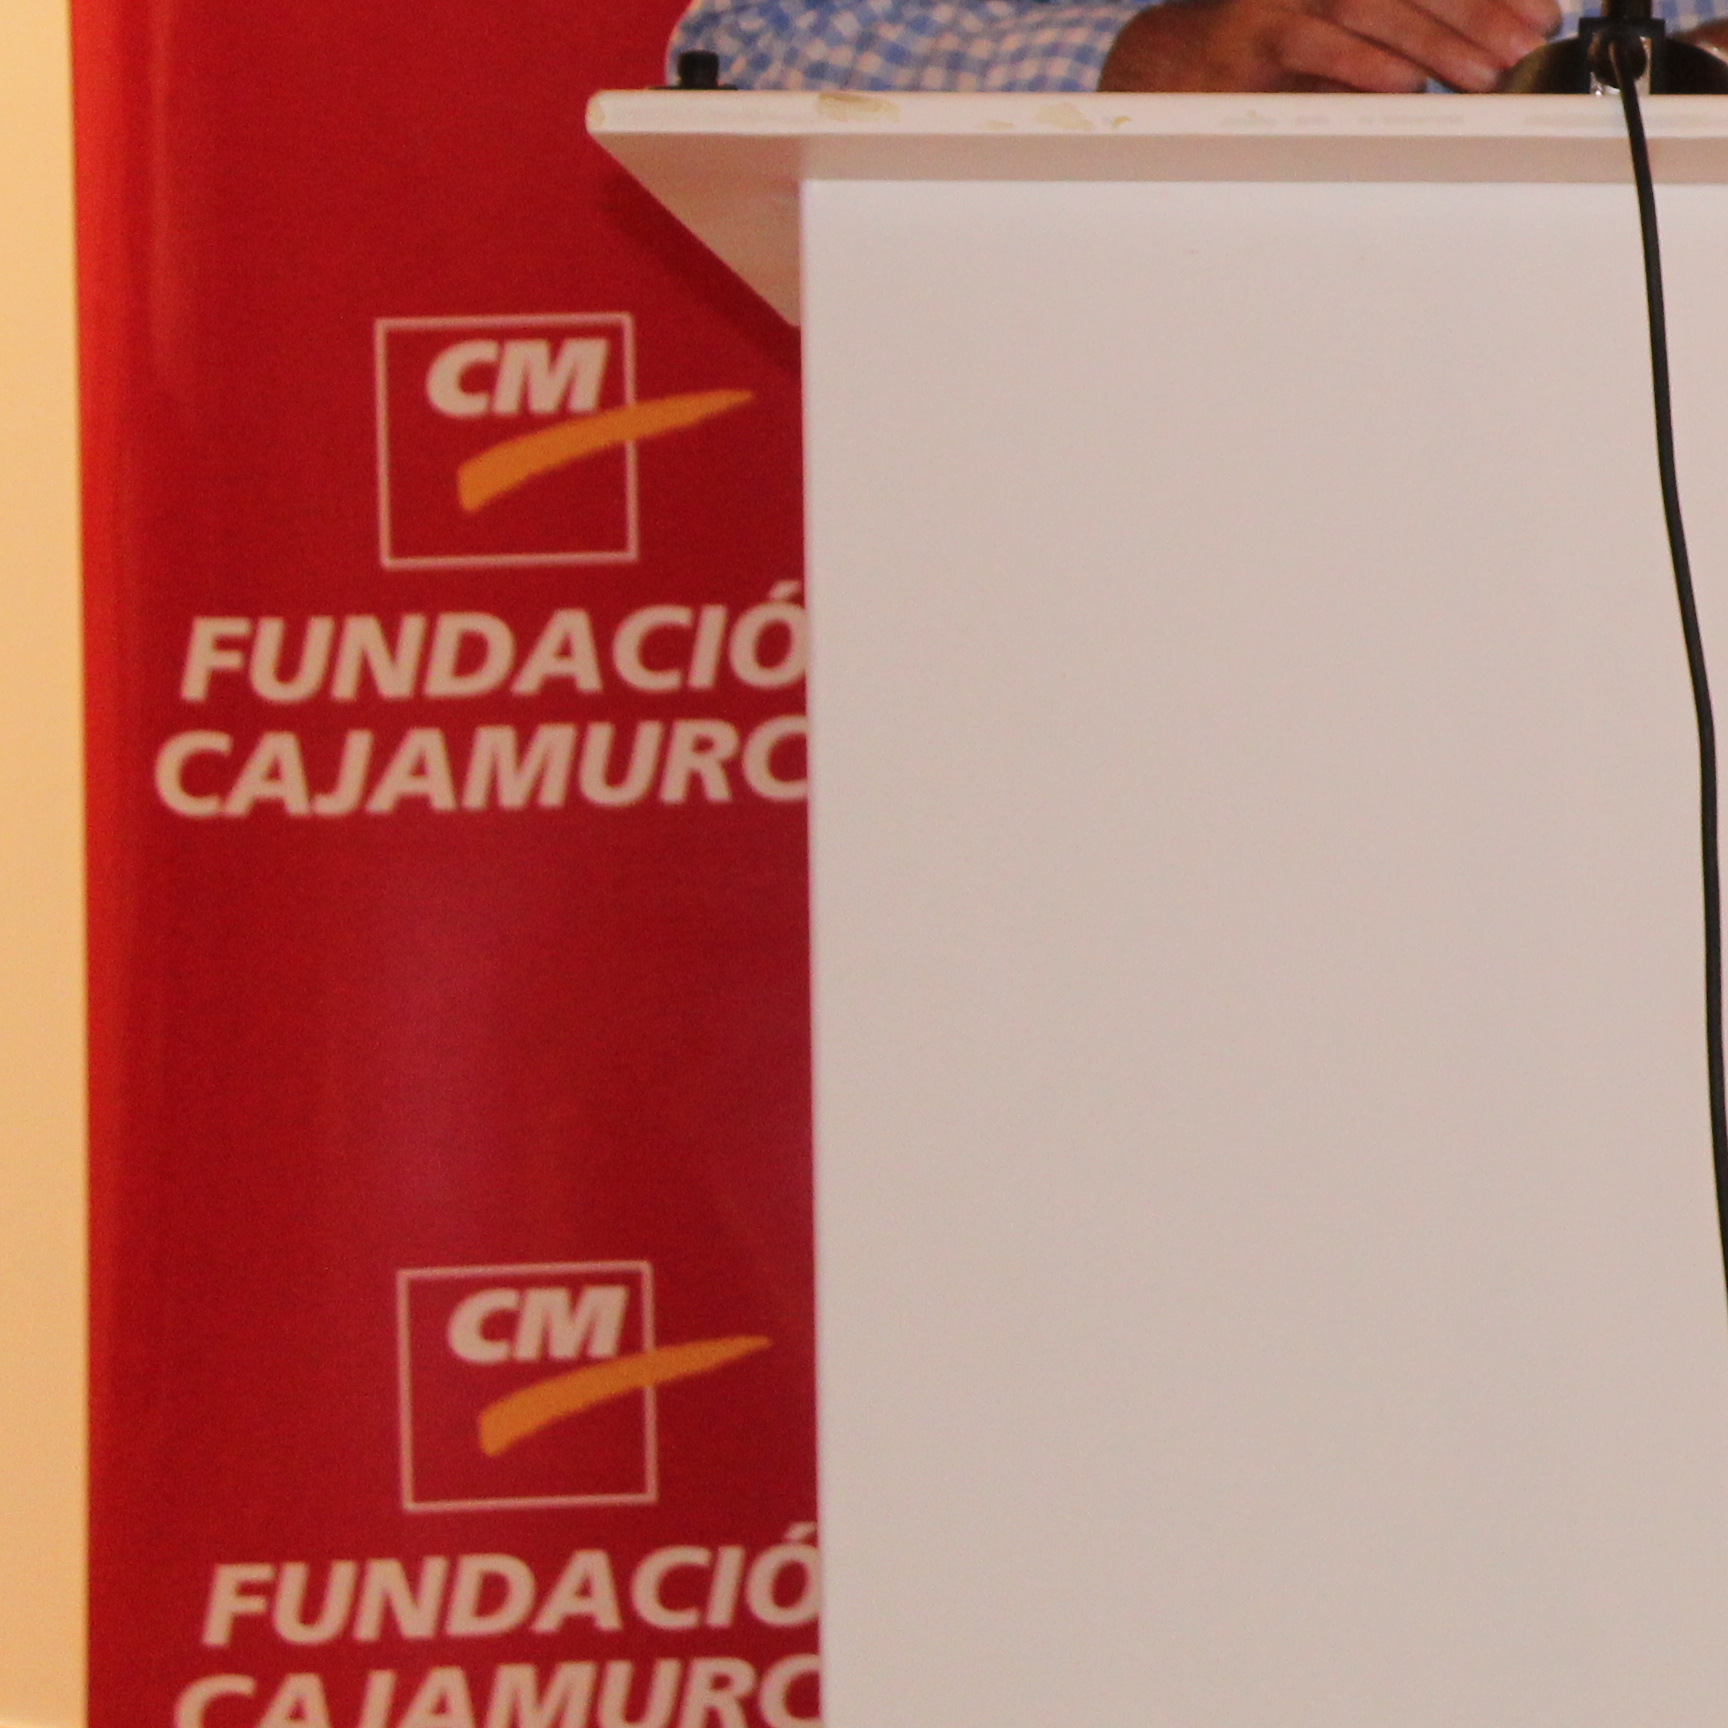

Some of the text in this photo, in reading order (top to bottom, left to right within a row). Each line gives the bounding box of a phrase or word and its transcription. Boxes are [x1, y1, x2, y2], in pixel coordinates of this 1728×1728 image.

[426, 339, 609, 418] CM
[180, 580, 808, 702] FUNDACIÓ
[154, 716, 810, 817] CAJAMURC
[447, 1286, 628, 1363] CM
[201, 1523, 822, 1647] FUNDACIÓ
[173, 1655, 823, 1728] CAJAMURC
